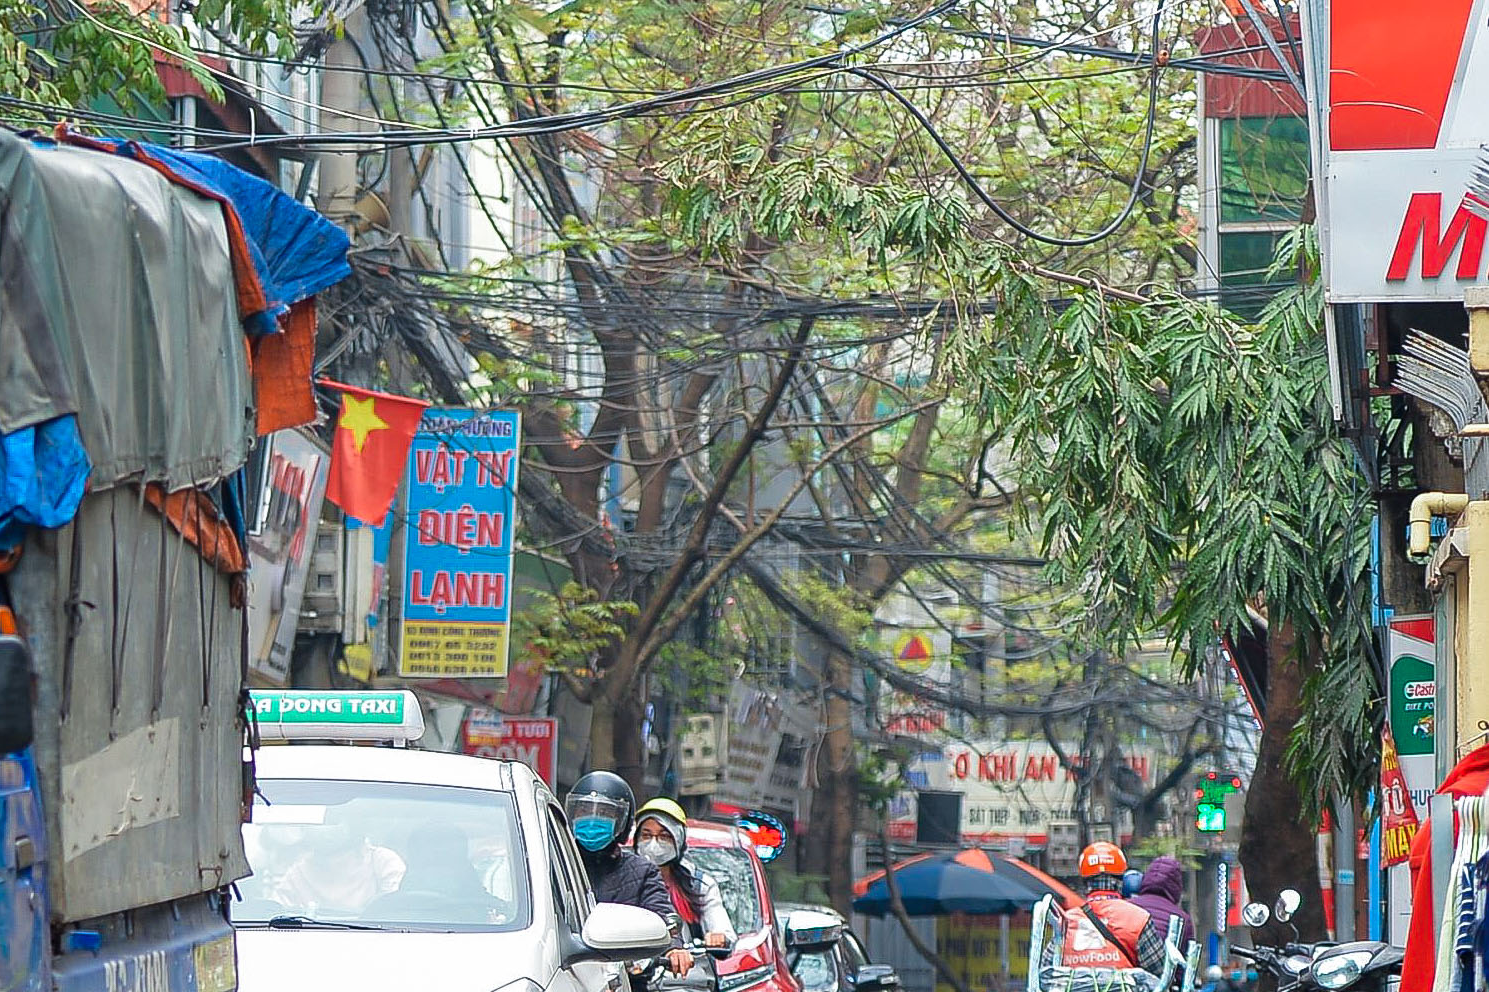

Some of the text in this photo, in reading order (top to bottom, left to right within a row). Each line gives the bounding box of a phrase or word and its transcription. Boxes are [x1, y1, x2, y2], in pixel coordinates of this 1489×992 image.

[1385, 192, 1489, 283] M
[416, 442, 469, 493] VẬT
[418, 504, 503, 553] ĐIỆN
[410, 570, 506, 614] LẠNH
[346, 698, 397, 714] TAXI
[1024, 755, 1057, 783] AN
